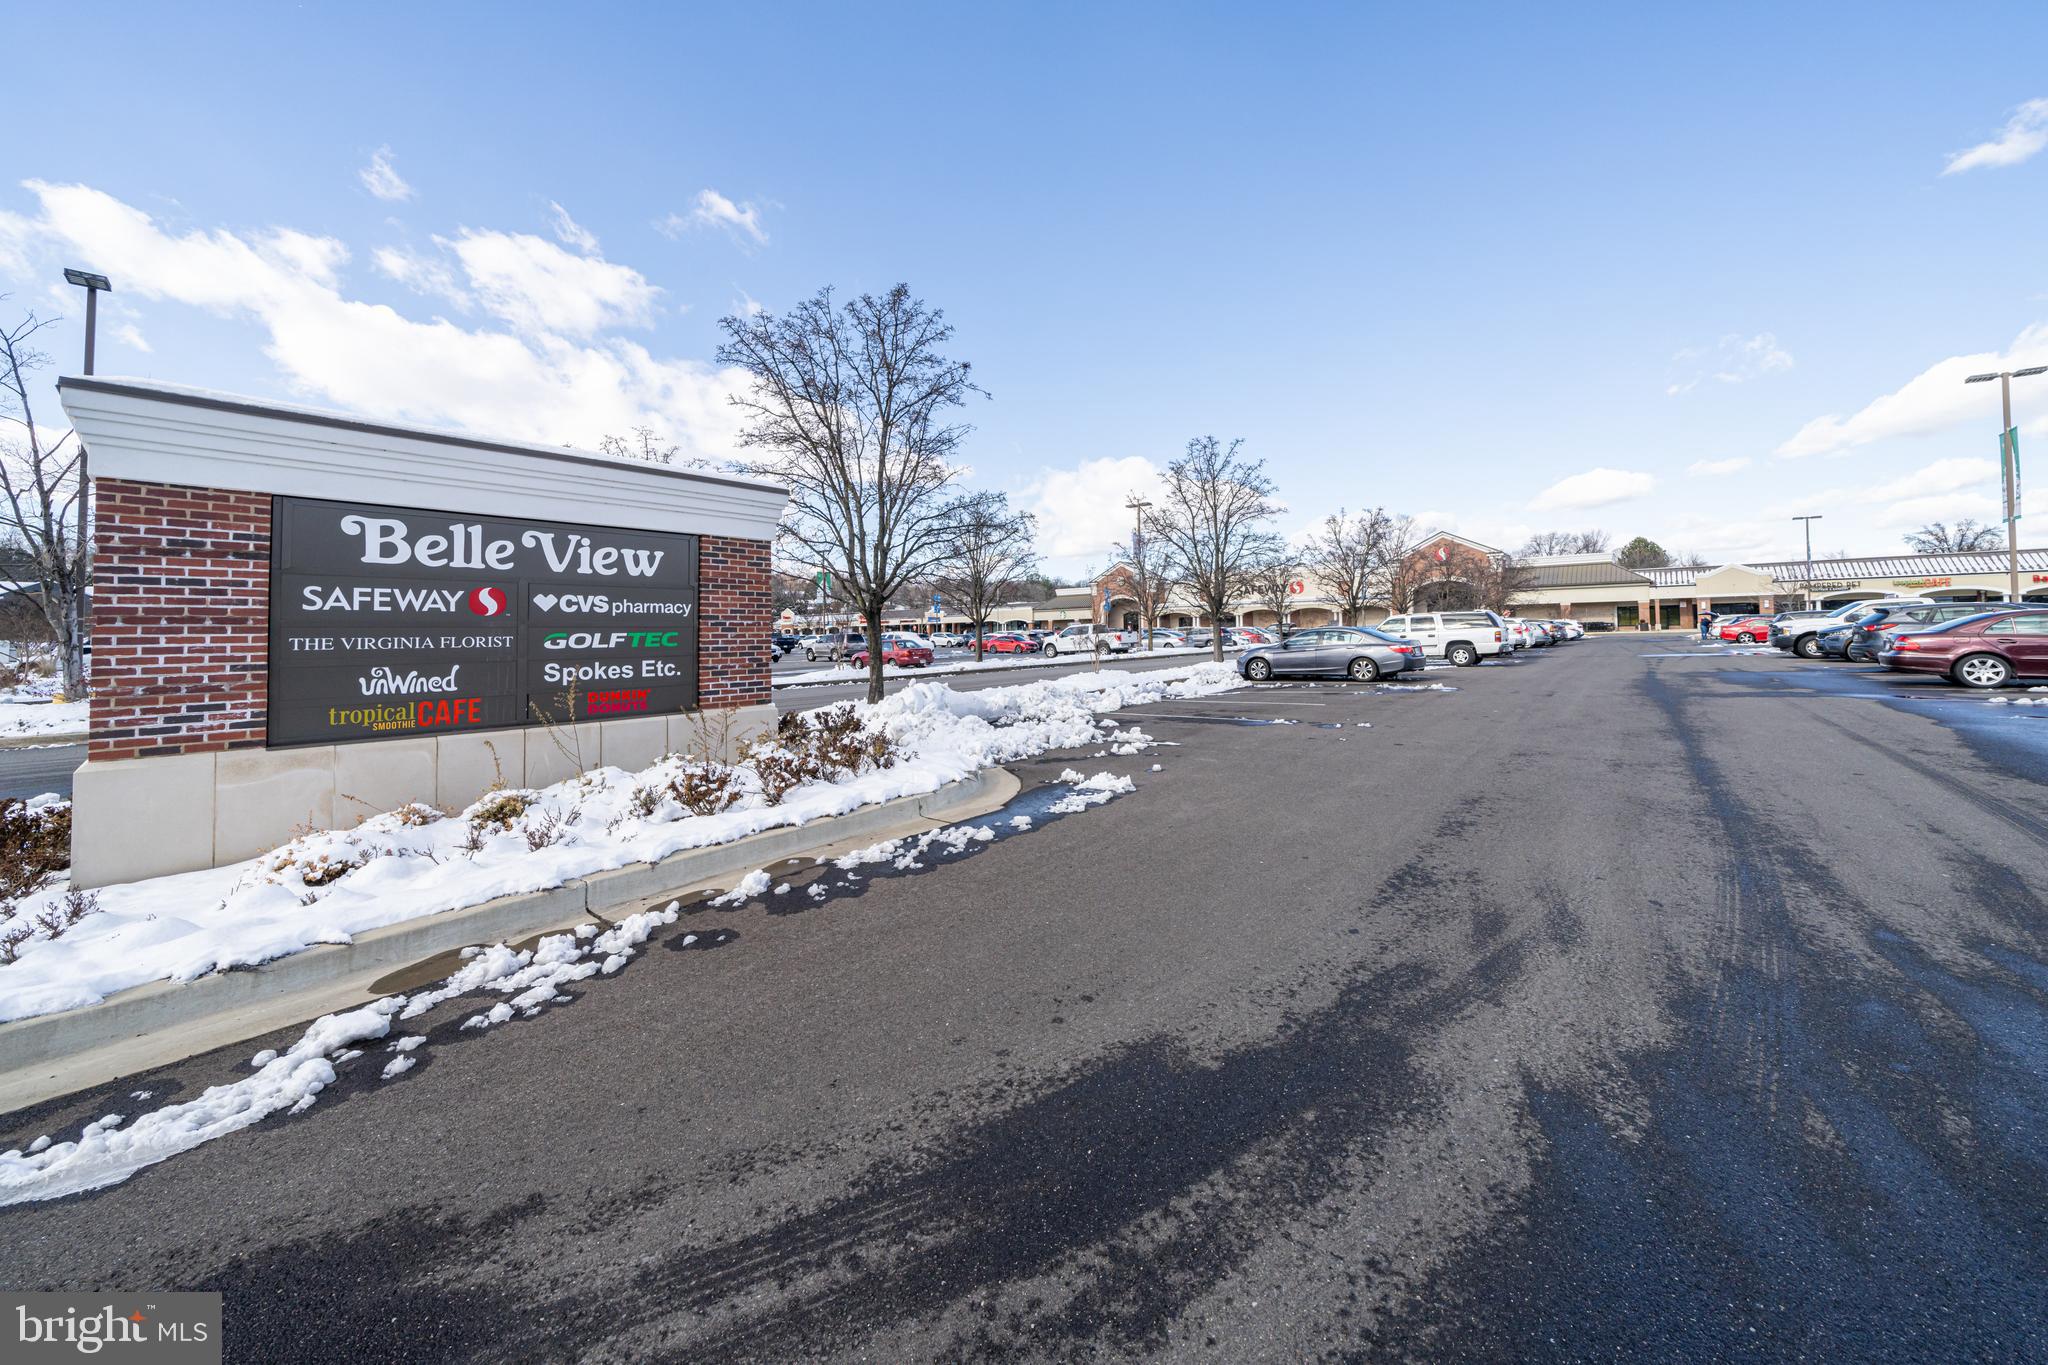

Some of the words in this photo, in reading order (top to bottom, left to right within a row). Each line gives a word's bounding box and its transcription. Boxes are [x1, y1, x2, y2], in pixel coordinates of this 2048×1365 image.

[340, 514, 515, 570] Belle
[521, 530, 665, 577] View
[302, 585, 465, 612] SAFEWAY
[559, 594, 609, 613] CVS
[612, 599, 692, 616] pharmacy
[288, 637, 334, 651] THE
[340, 637, 435, 650] VIRGINIA
[439, 636, 514, 649] FLORIST
[543, 631, 679, 650] GOLFTEC
[543, 662, 634, 686] Spokes
[641, 660, 681, 677] Etc.
[328, 702, 416, 727] tropical
[417, 698, 481, 728] CAFE
[587, 701, 648, 714] DONUTS
[372, 719, 416, 731] SMOOTHIE
